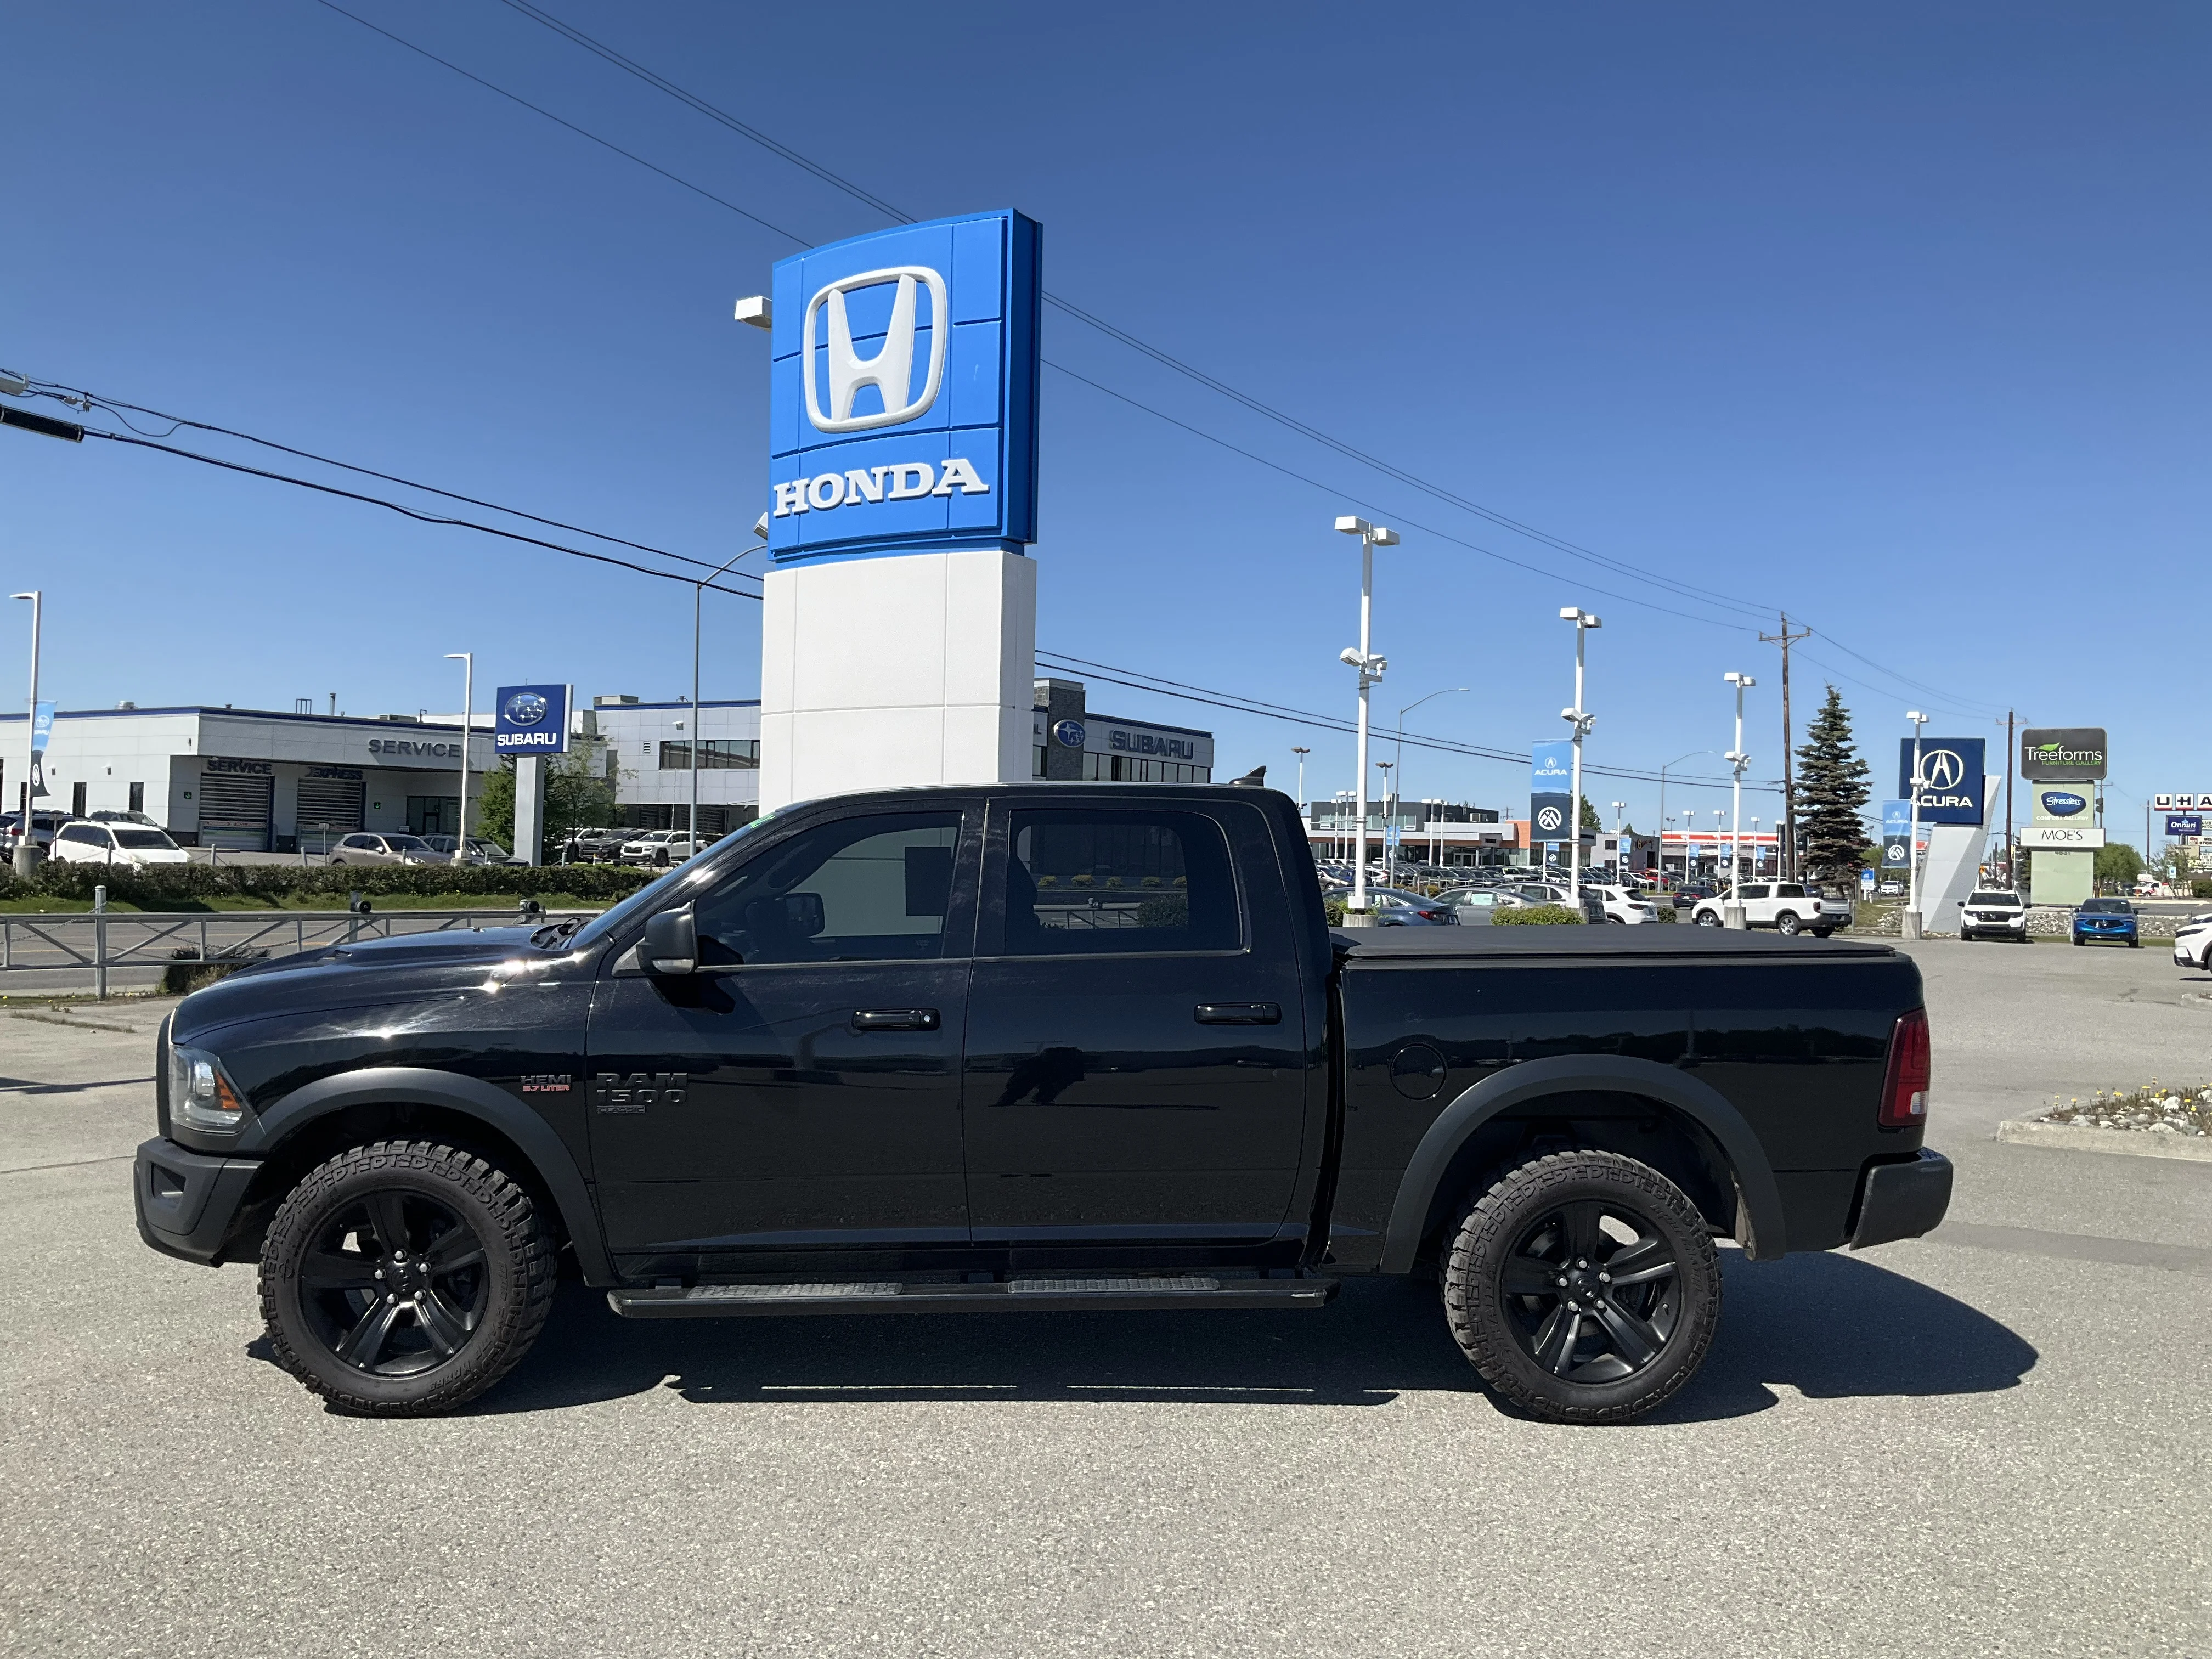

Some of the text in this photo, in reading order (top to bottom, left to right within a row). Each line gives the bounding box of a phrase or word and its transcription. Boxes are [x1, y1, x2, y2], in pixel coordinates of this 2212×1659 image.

[773, 459, 989, 517] HONDA
[498, 733, 556, 746] SUBARU
[1110, 729, 1194, 760] SUBARU
[368, 738, 461, 758] SERVICE
[2024, 746, 2102, 760] Treeforms
[207, 759, 272, 775] SERVICE
[2046, 797, 2081, 805] Stressless
[2041, 830, 2083, 840] MOE'S
[521, 1075, 571, 1084] HEMI
[597, 1073, 687, 1087] RAM
[597, 1089, 686, 1103] 1500
